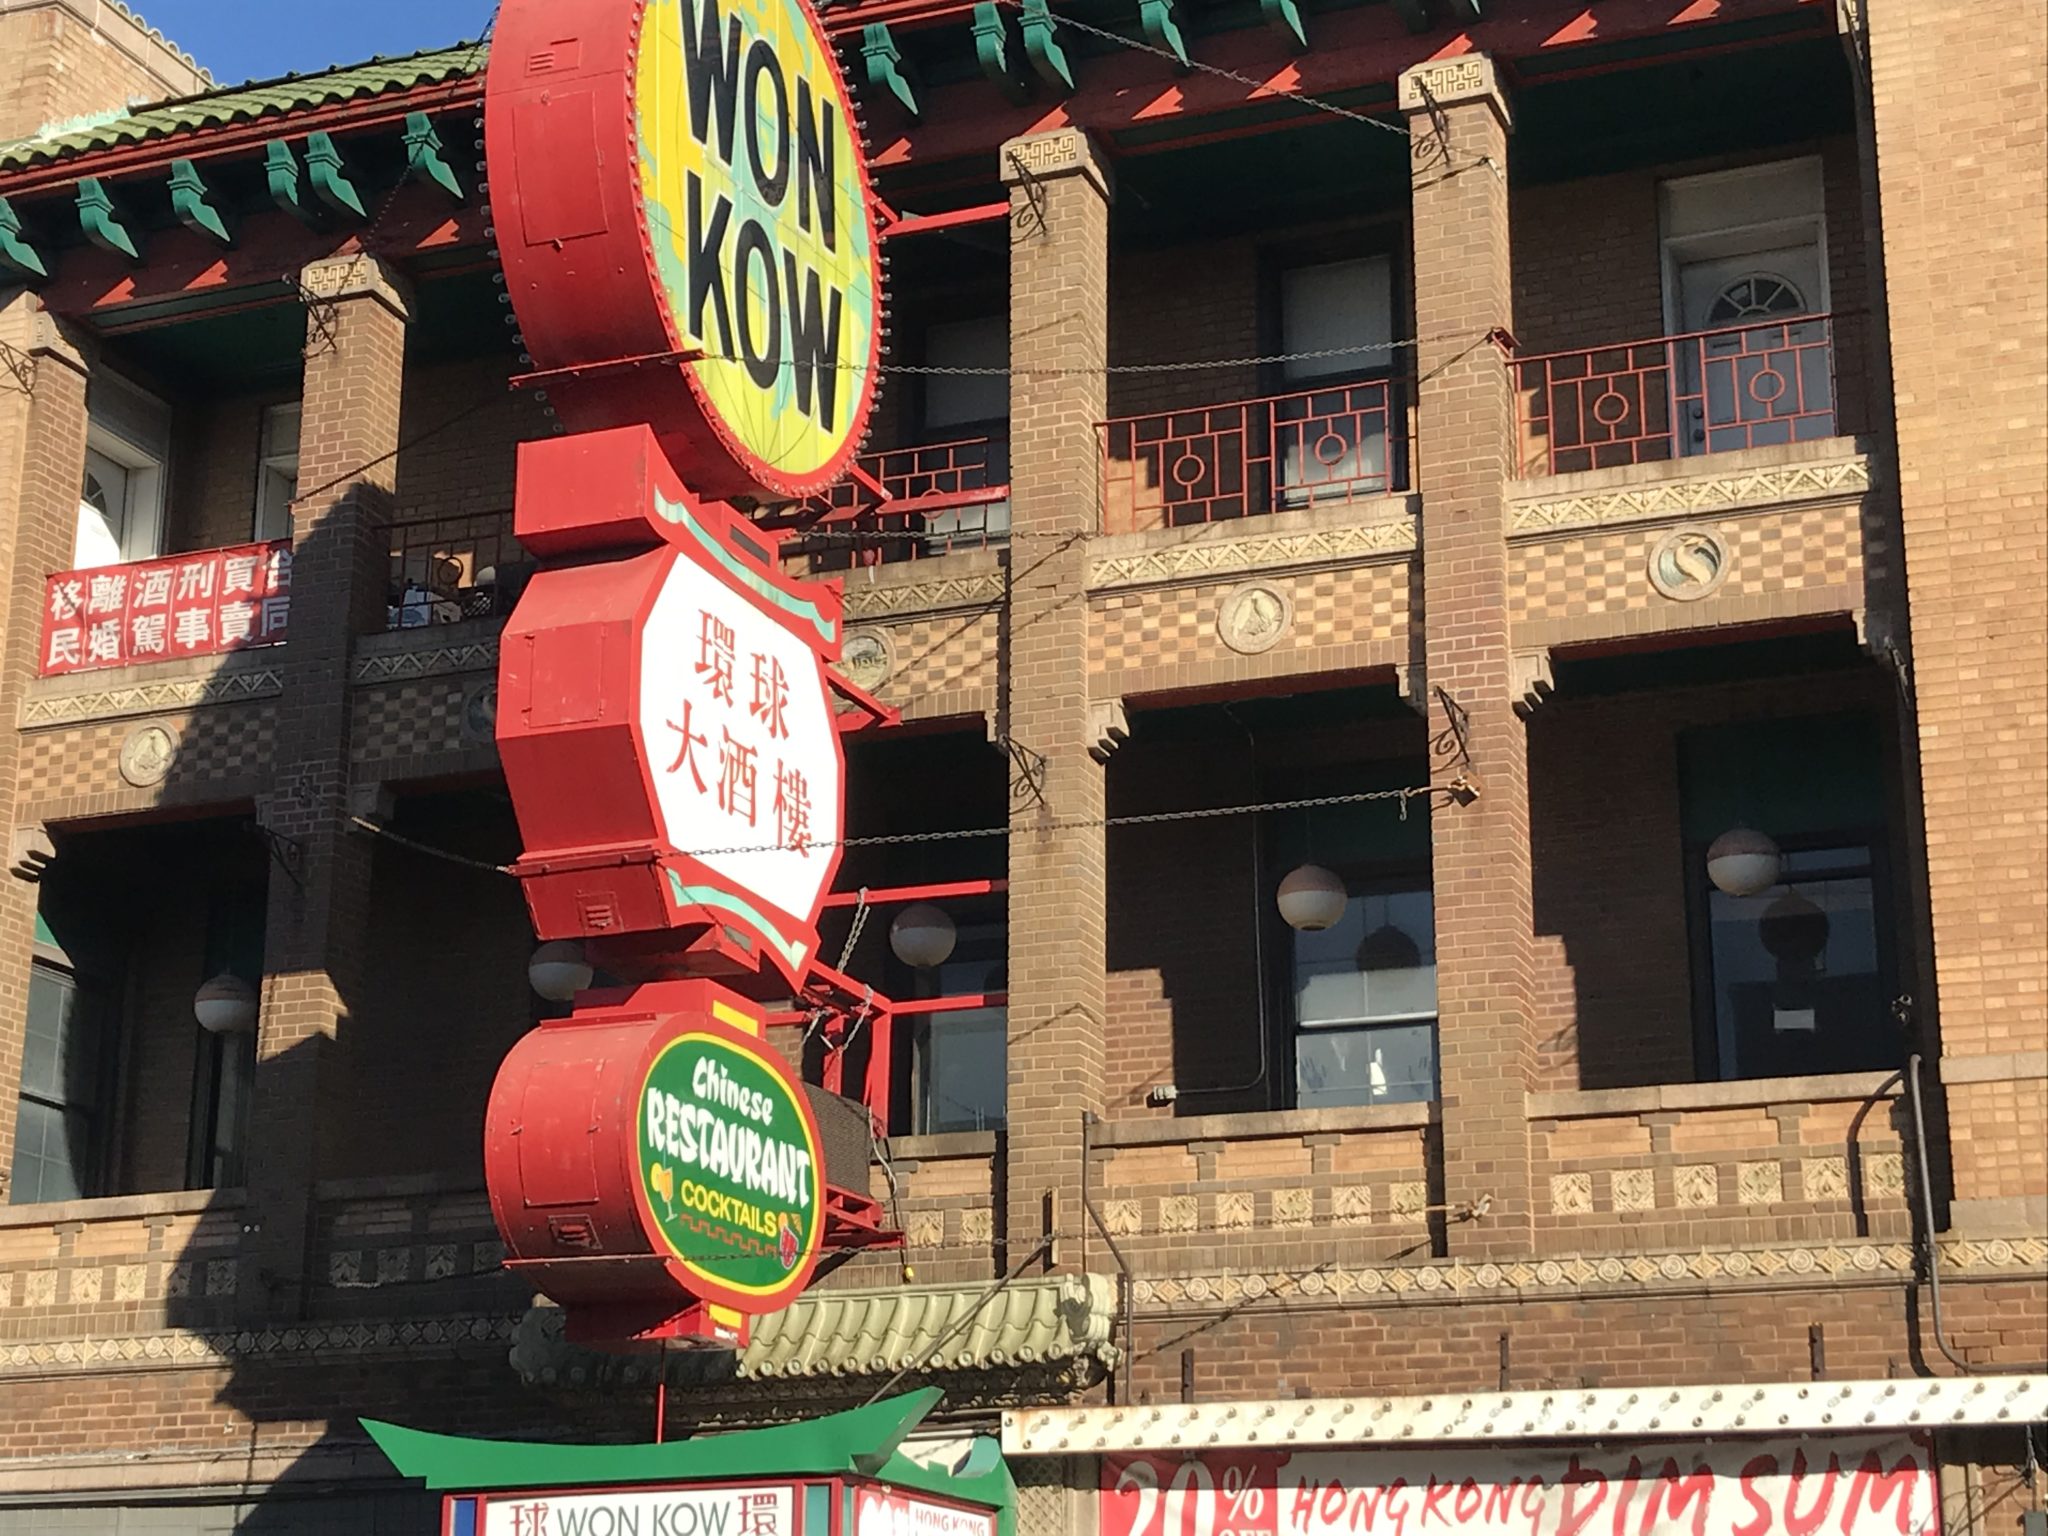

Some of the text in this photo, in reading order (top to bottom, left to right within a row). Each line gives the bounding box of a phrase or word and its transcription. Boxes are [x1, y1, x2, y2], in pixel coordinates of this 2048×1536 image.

[680, 0, 836, 254] WON
[686, 169, 842, 435] KOW
[694, 608, 790, 740] 環球
[665, 698, 812, 858] 大酒樓
[692, 1056, 774, 1127] Chinese
[647, 1087, 811, 1209] RESTAURANT
[680, 1179, 778, 1238] COCKTAILS
[557, 1505, 639, 1536] WON
[653, 1501, 731, 1536] KOW
[915, 1508, 949, 1532] HONG
[1290, 1447, 1919, 1536] HONG KONG DIM SUM
